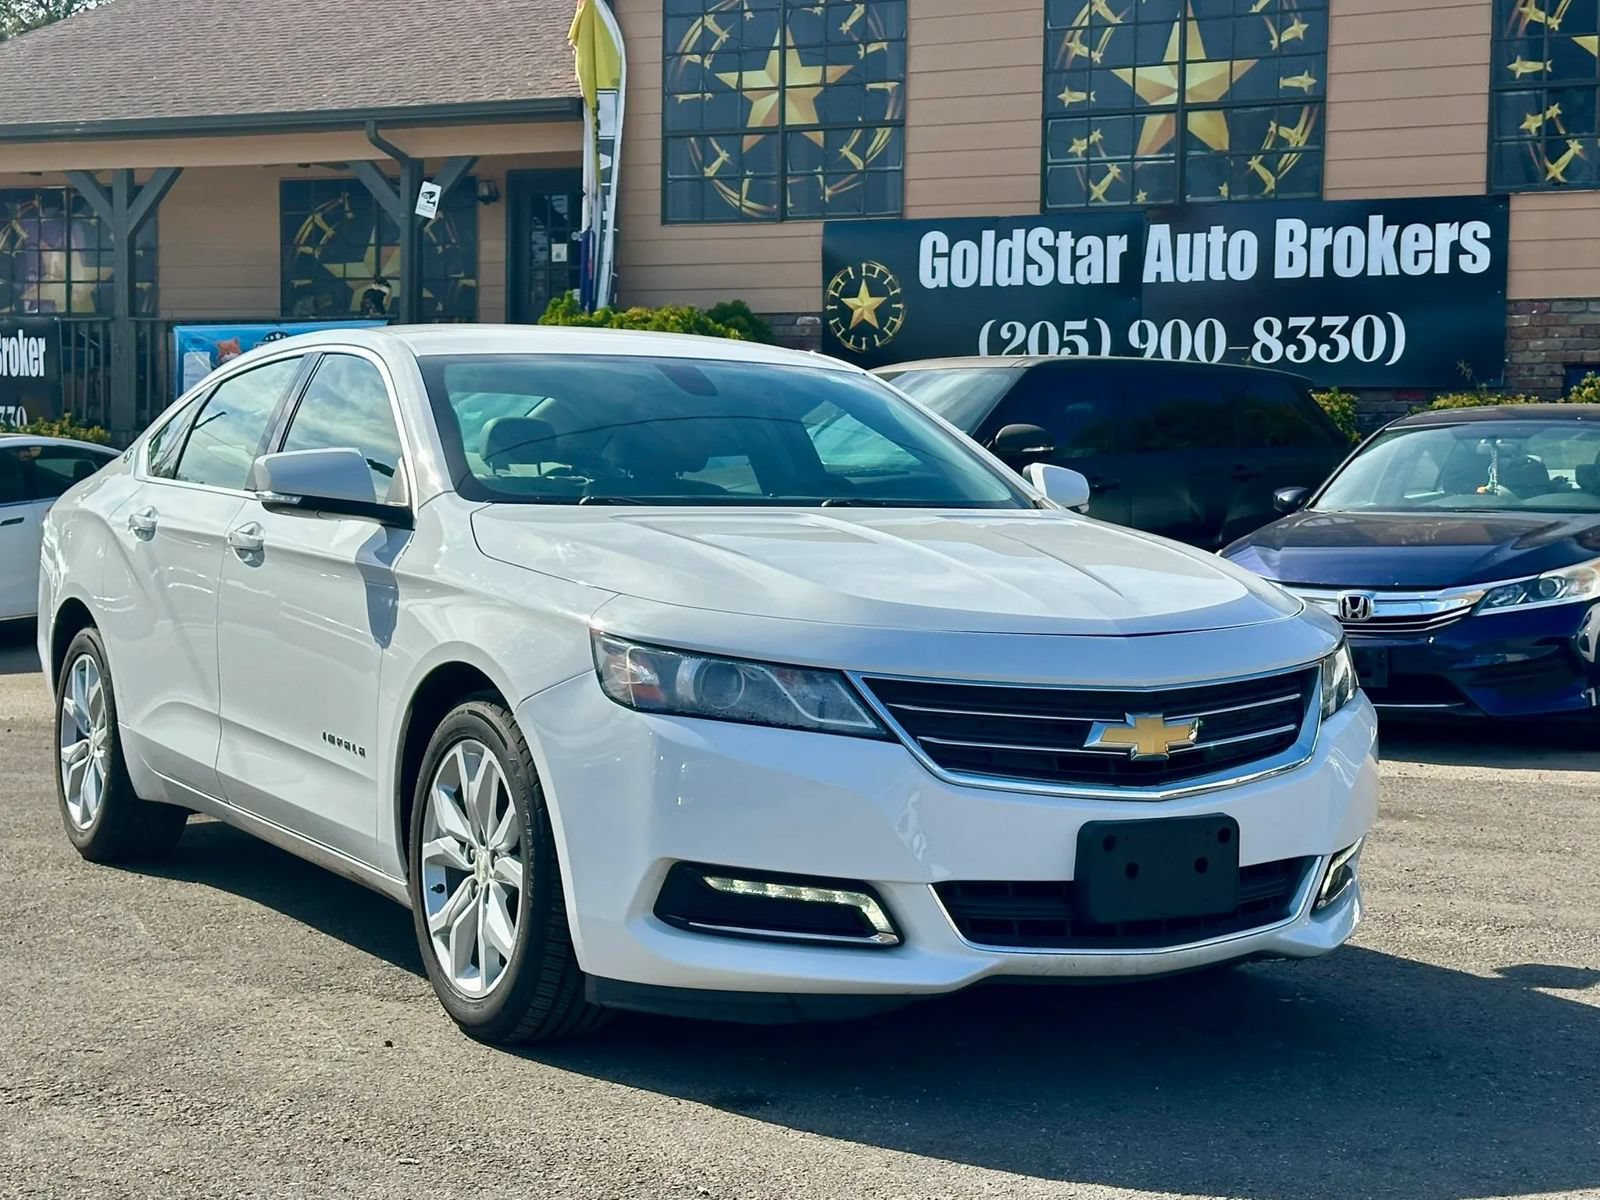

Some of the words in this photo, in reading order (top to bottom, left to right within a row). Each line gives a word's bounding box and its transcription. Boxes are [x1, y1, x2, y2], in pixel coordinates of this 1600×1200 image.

[919, 226, 1128, 289] GoldStar
[1142, 224, 1258, 283] Auto
[1274, 215, 1491, 279] Brokers
[0, 329, 46, 377] roker
[978, 317, 1111, 357] (205)
[1128, 311, 1406, 365] 900-8330)
